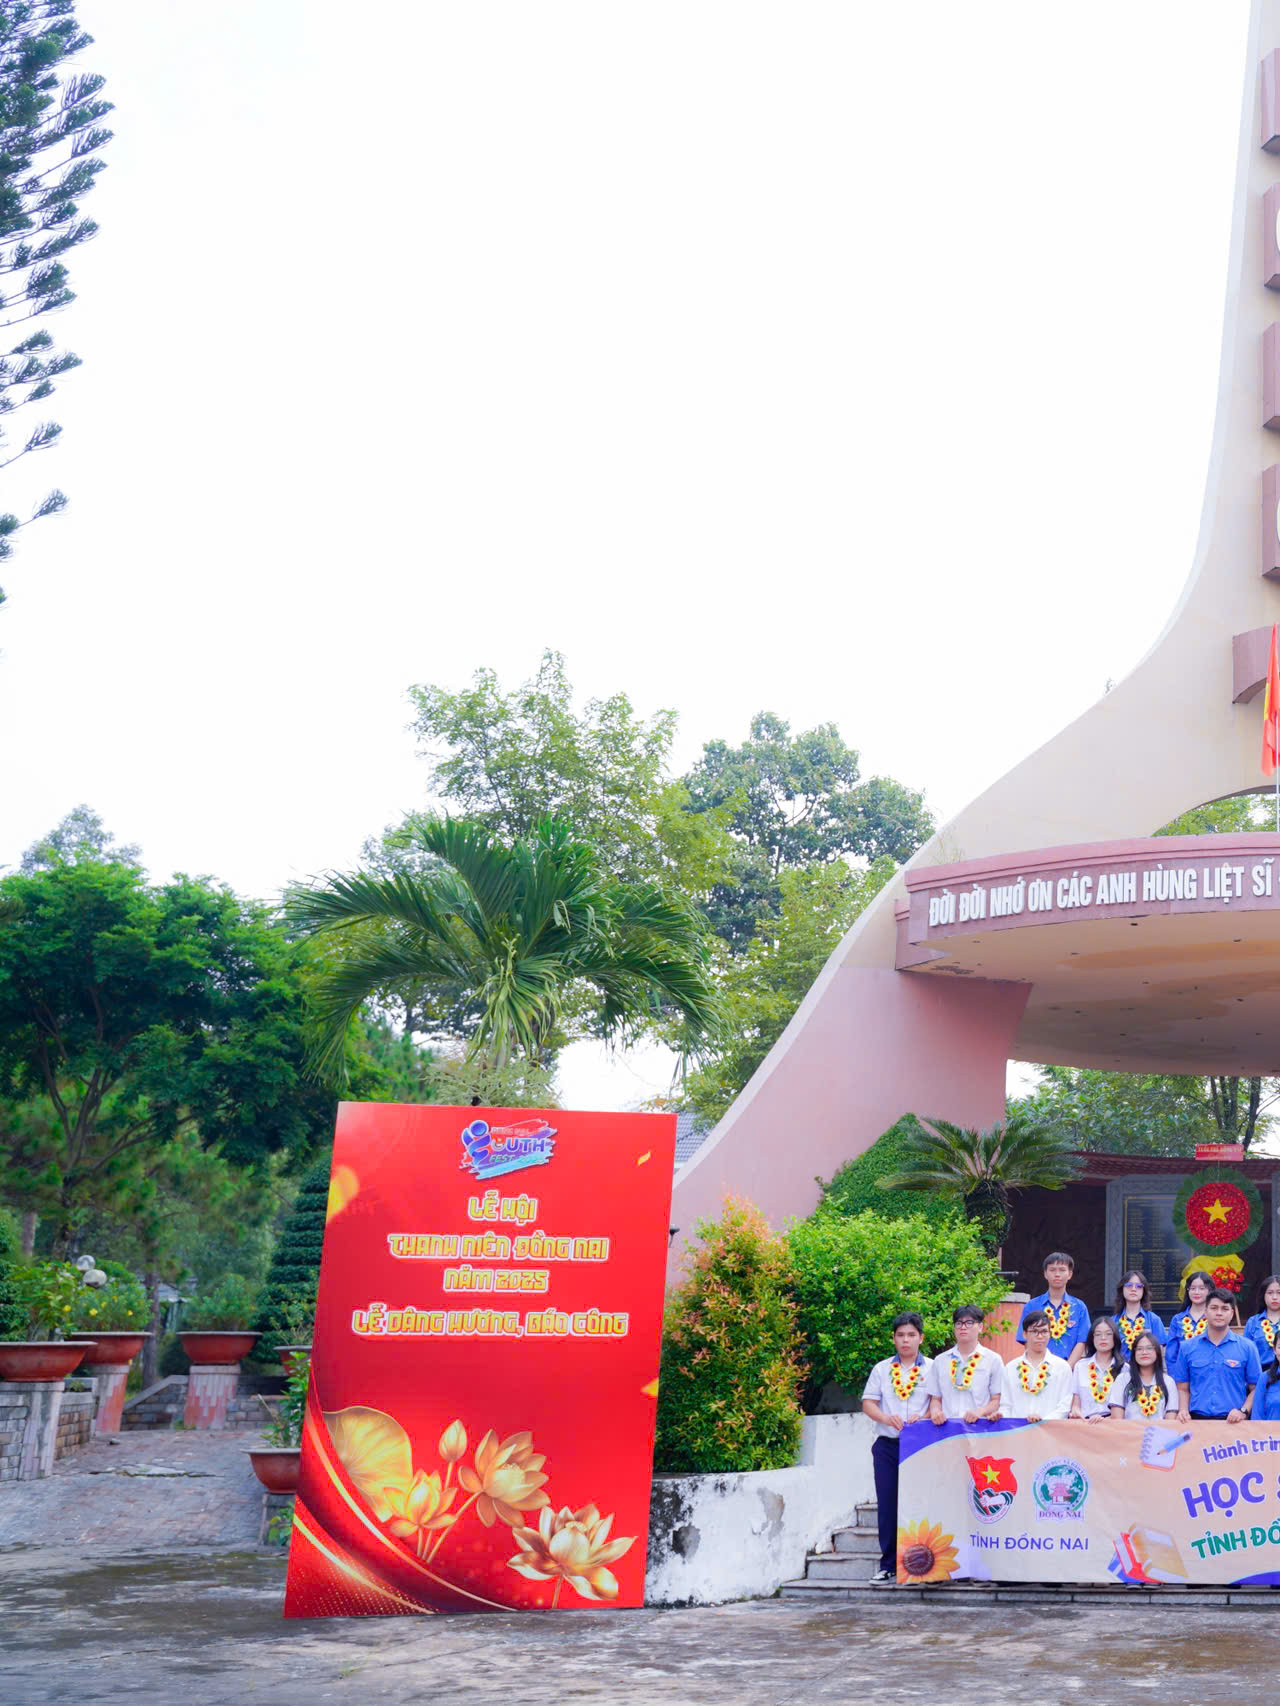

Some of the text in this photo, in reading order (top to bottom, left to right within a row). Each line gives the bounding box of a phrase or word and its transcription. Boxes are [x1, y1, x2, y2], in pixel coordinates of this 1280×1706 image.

[929, 888, 956, 927] ĐỜI
[959, 883, 987, 922] ĐỜI
[990, 876, 1026, 917] NHỚ
[1028, 878, 1054, 912] ƠN
[1057, 871, 1093, 909] CÁC
[1096, 872, 1137, 905] ANH
[1143, 863, 1198, 902] HÙNG
[1203, 862, 1245, 904] LIỆT
[1252, 857, 1276, 897] SĨ
[468, 1191, 537, 1225] LỄ HỘI
[388, 1230, 608, 1261] THANH NIÊN ĐỒNG NAI
[443, 1265, 549, 1292] NĂM 2025
[352, 1303, 629, 1337] LỄ DÂNG HƯƠNG, BÁO CÔNG
[1203, 1440, 1248, 1463] Hành
[1182, 1472, 1265, 1518] HỌC
[1191, 1531, 1247, 1558] TỈNH
